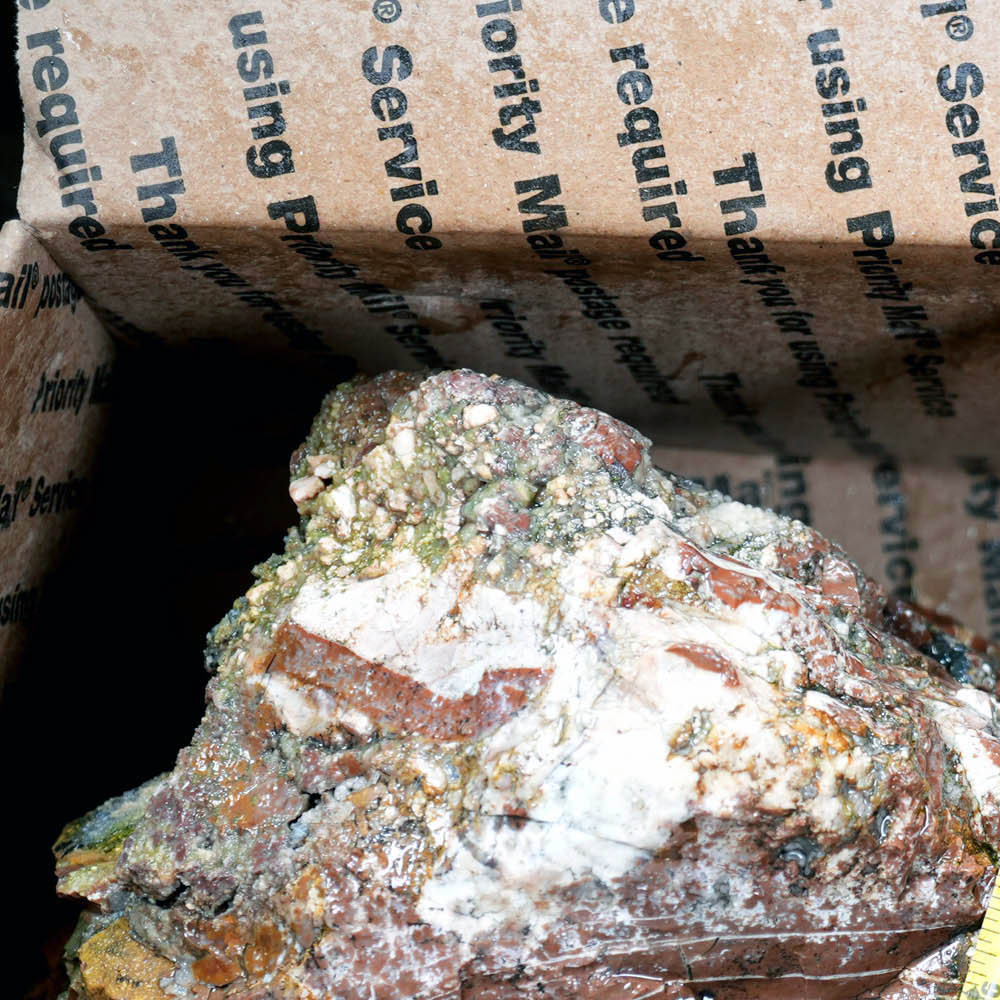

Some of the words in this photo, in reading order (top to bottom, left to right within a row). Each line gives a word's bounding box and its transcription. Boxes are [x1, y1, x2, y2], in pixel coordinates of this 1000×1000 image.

[26, 29, 135, 252] required
[227, 10, 295, 179] using
[361, 44, 443, 251] Service
[610, 43, 705, 263] required
[806, 28, 872, 193] using
[514, 173, 591, 267] Mail®
[713, 151, 787, 275] Thank
